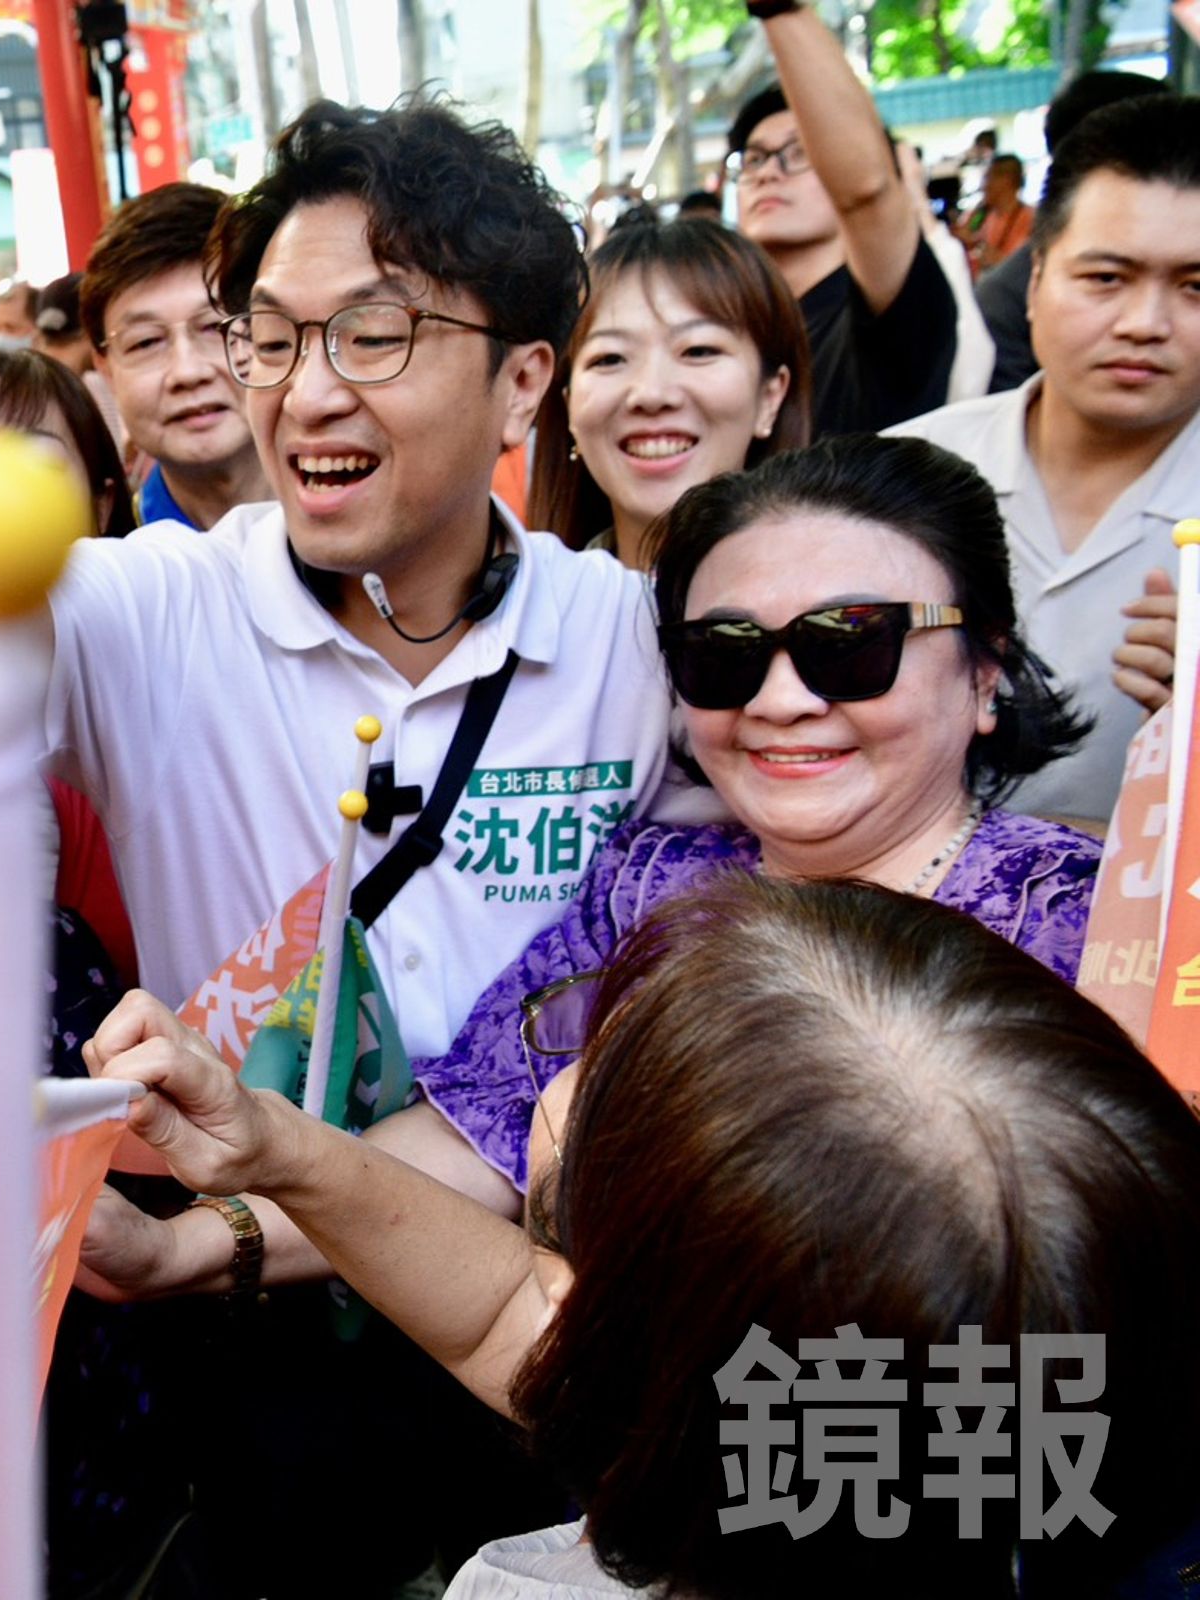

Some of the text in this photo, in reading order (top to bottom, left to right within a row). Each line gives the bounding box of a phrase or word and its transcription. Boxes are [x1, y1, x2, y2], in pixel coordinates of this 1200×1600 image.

[480, 764, 623, 794] 台北市長候選人
[484, 884, 552, 902] PUMA
